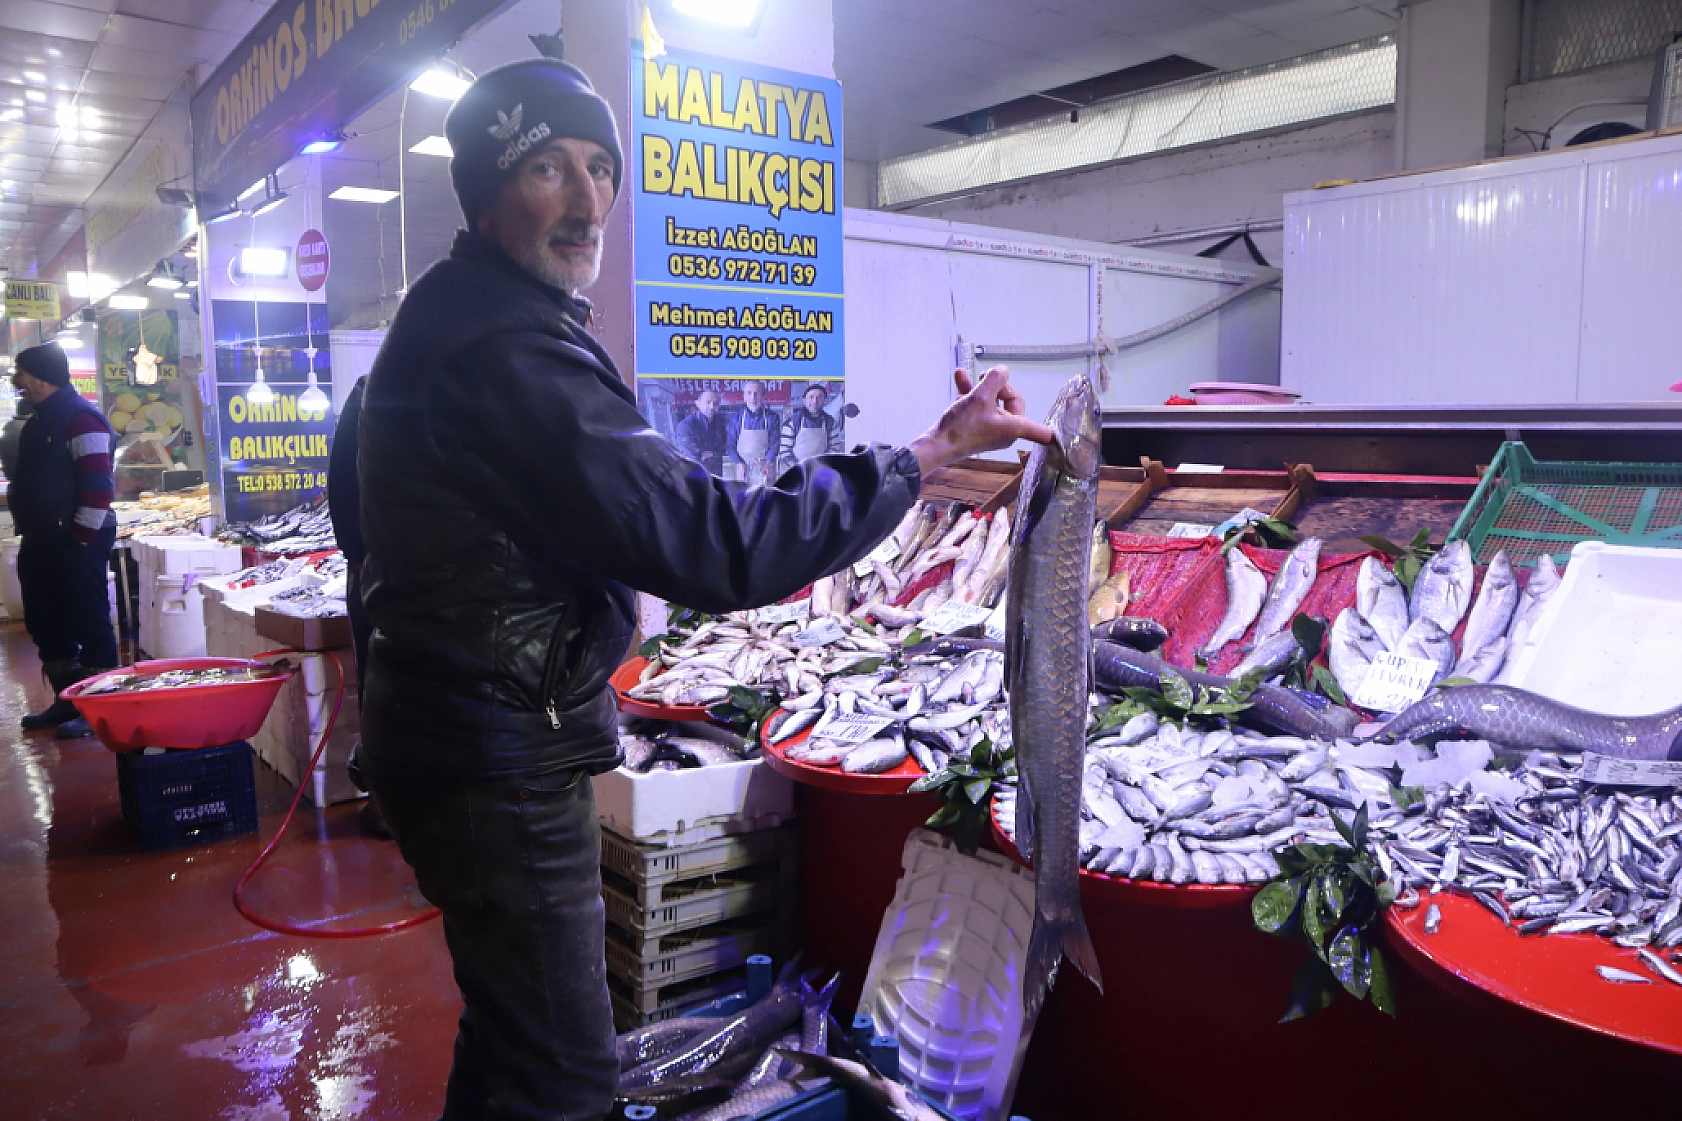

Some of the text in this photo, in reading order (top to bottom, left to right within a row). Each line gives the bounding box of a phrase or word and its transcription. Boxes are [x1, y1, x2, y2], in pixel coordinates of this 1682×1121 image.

[216, 3, 307, 145] ORKİNOS
[643, 59, 834, 148] MALATYA
[497, 122, 551, 171] adidas
[642, 133, 835, 221] BALIKÇISI
[667, 216, 817, 258] İzzet AĞOĞLAN
[669, 253, 816, 286] 0536 972 71 39
[650, 301, 833, 333] Mehmet AĞOĞLAN
[670, 333, 817, 361] 0545 908 03 20
[230, 434, 328, 465] BALIKÇILIK
